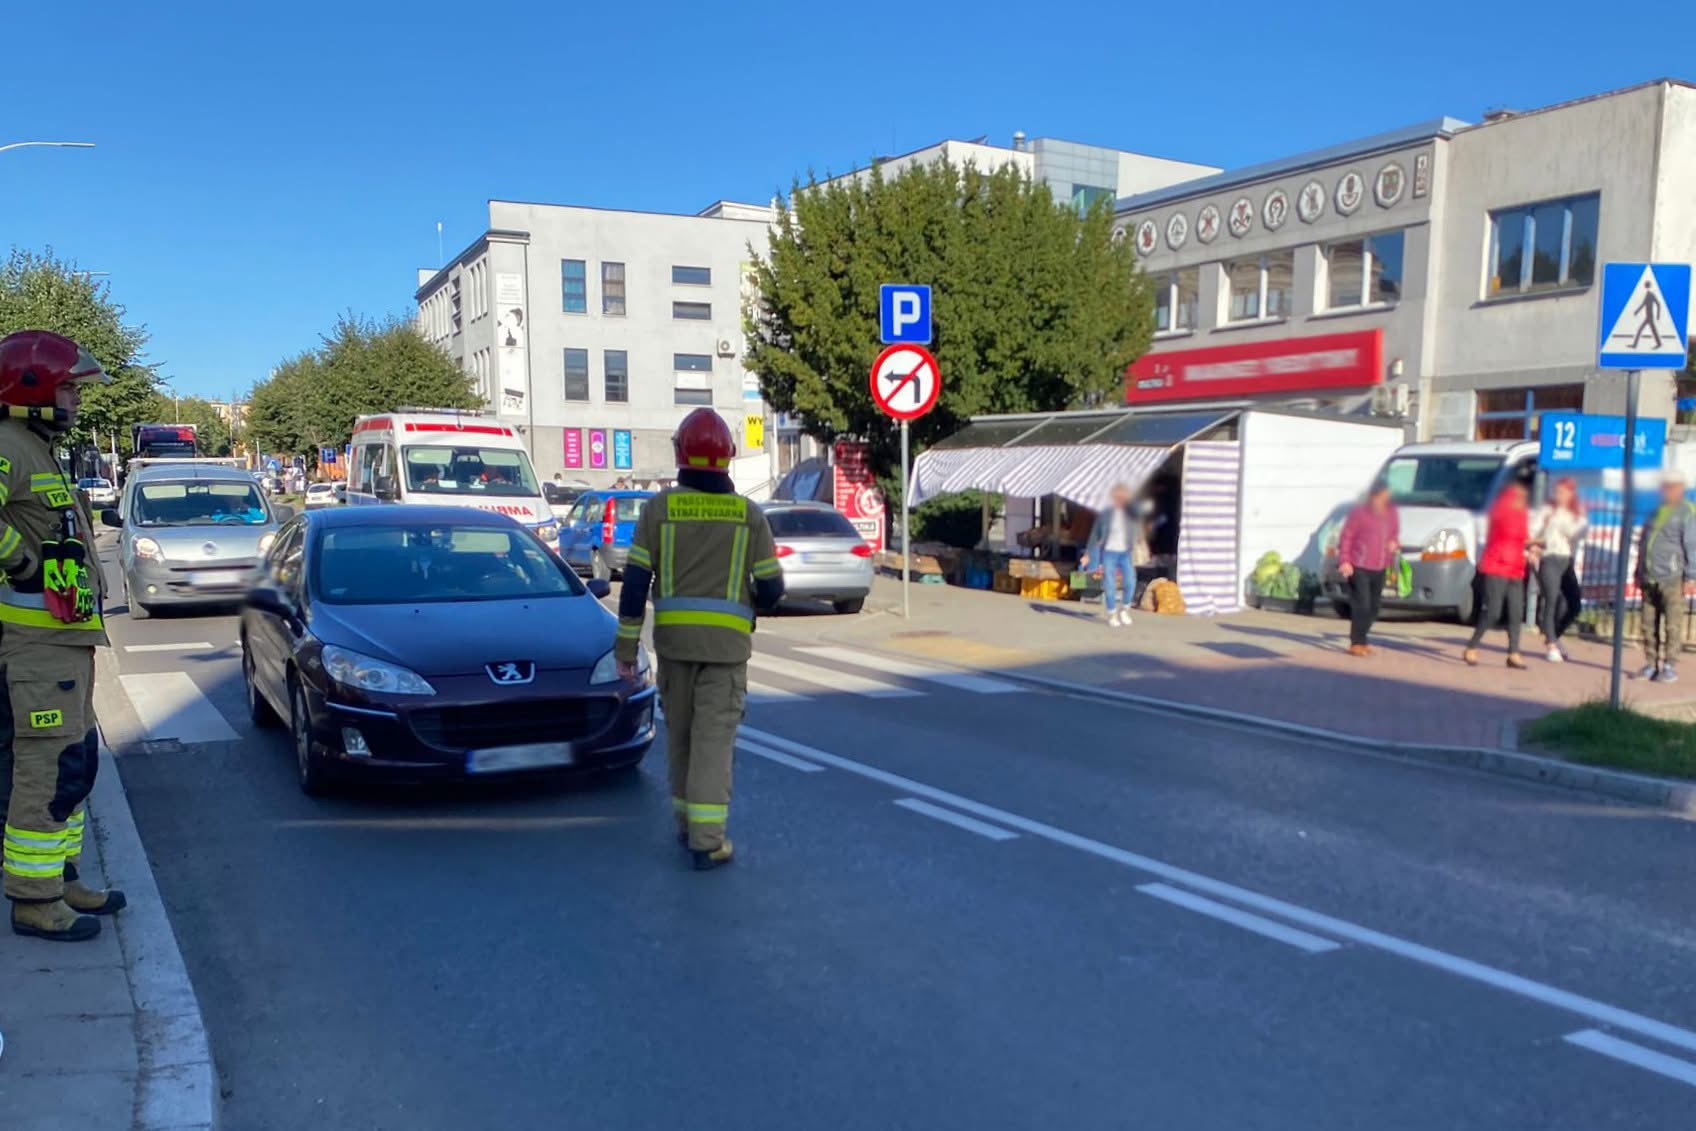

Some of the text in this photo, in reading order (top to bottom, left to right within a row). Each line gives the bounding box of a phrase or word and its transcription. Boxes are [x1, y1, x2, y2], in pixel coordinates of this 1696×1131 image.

[892, 291, 921, 336] P
[1555, 421, 1575, 448] 12
[35, 712, 58, 725] PSP
